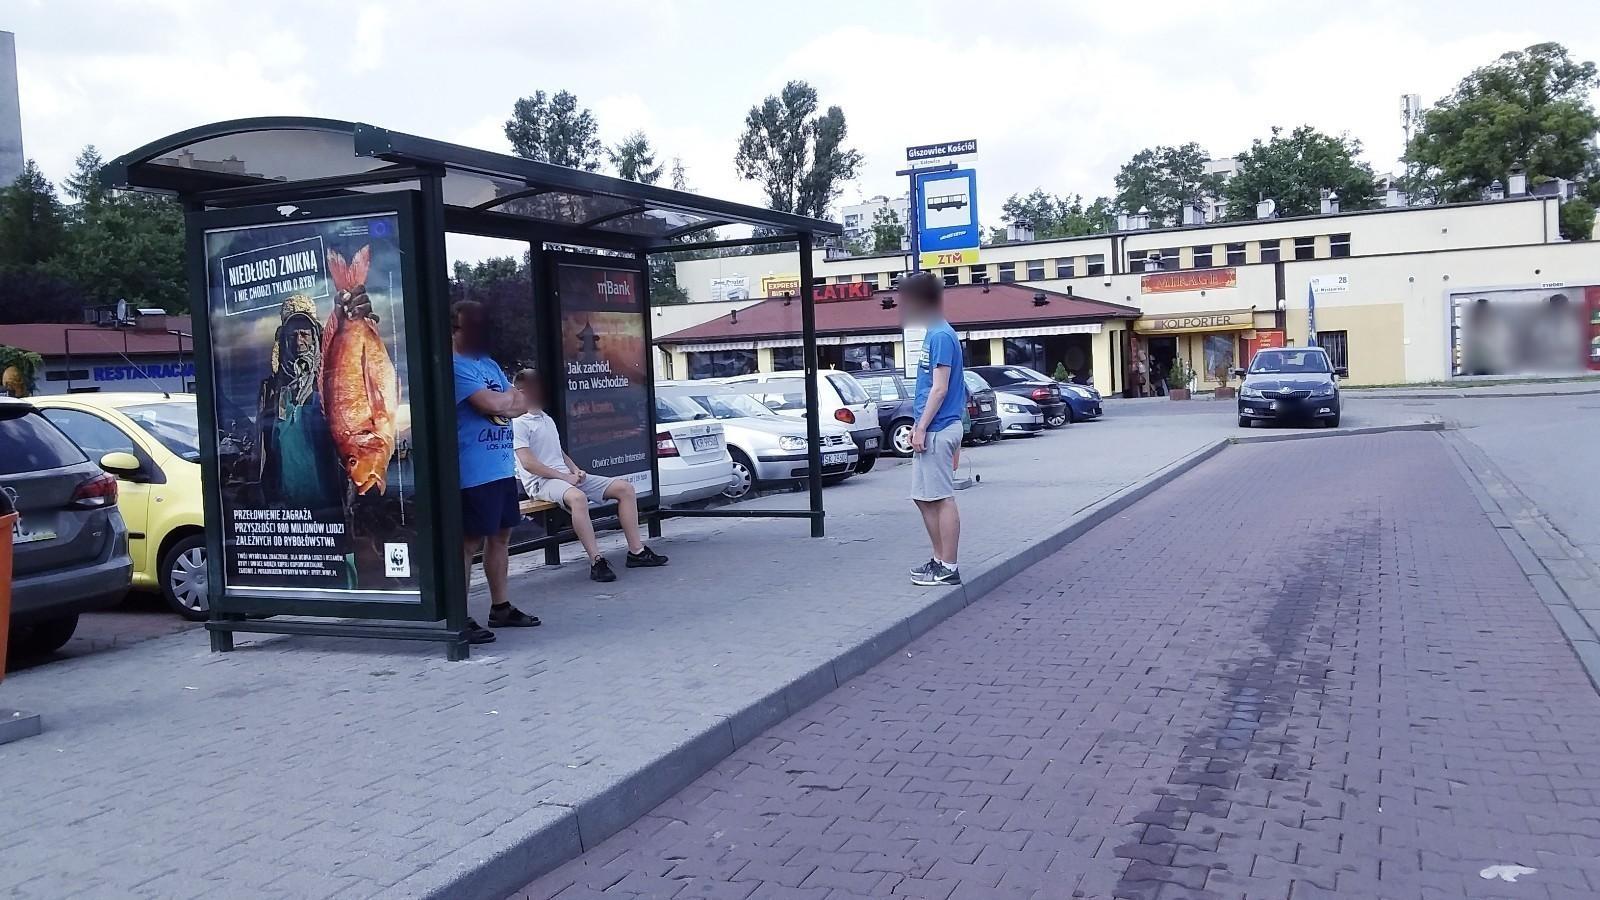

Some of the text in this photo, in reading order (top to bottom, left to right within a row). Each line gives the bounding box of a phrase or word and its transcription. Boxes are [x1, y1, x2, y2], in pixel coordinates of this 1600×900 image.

[908, 146, 946, 158] Giszowiec
[937, 252, 962, 265] ZTM
[228, 250, 318, 287] NIEDŁUGO ZNIKNĄ
[768, 281, 798, 290] EXPRESS
[1338, 276, 1348, 284] 28
[234, 275, 316, 303] I NIE CHODZI TYLKO O RYBY
[597, 280, 631, 296] mBank
[771, 289, 796, 297] BISTO
[1161, 315, 1231, 329] KOLPORTER
[567, 360, 612, 374] Jak zachód,
[568, 375, 629, 391] to na Wschodzie
[610, 455, 625, 465] konto
[233, 508, 312, 521] PRZEŁOWIENIE ZAGRAŻA
[234, 521, 276, 533] PRZYSZŁOŚCI
[290, 520, 325, 534] MILIONÓW
[325, 523, 345, 534] LUDZI
[235, 532, 336, 547] ZALEŻNYCH OD RYBOŁÓWSTWA
